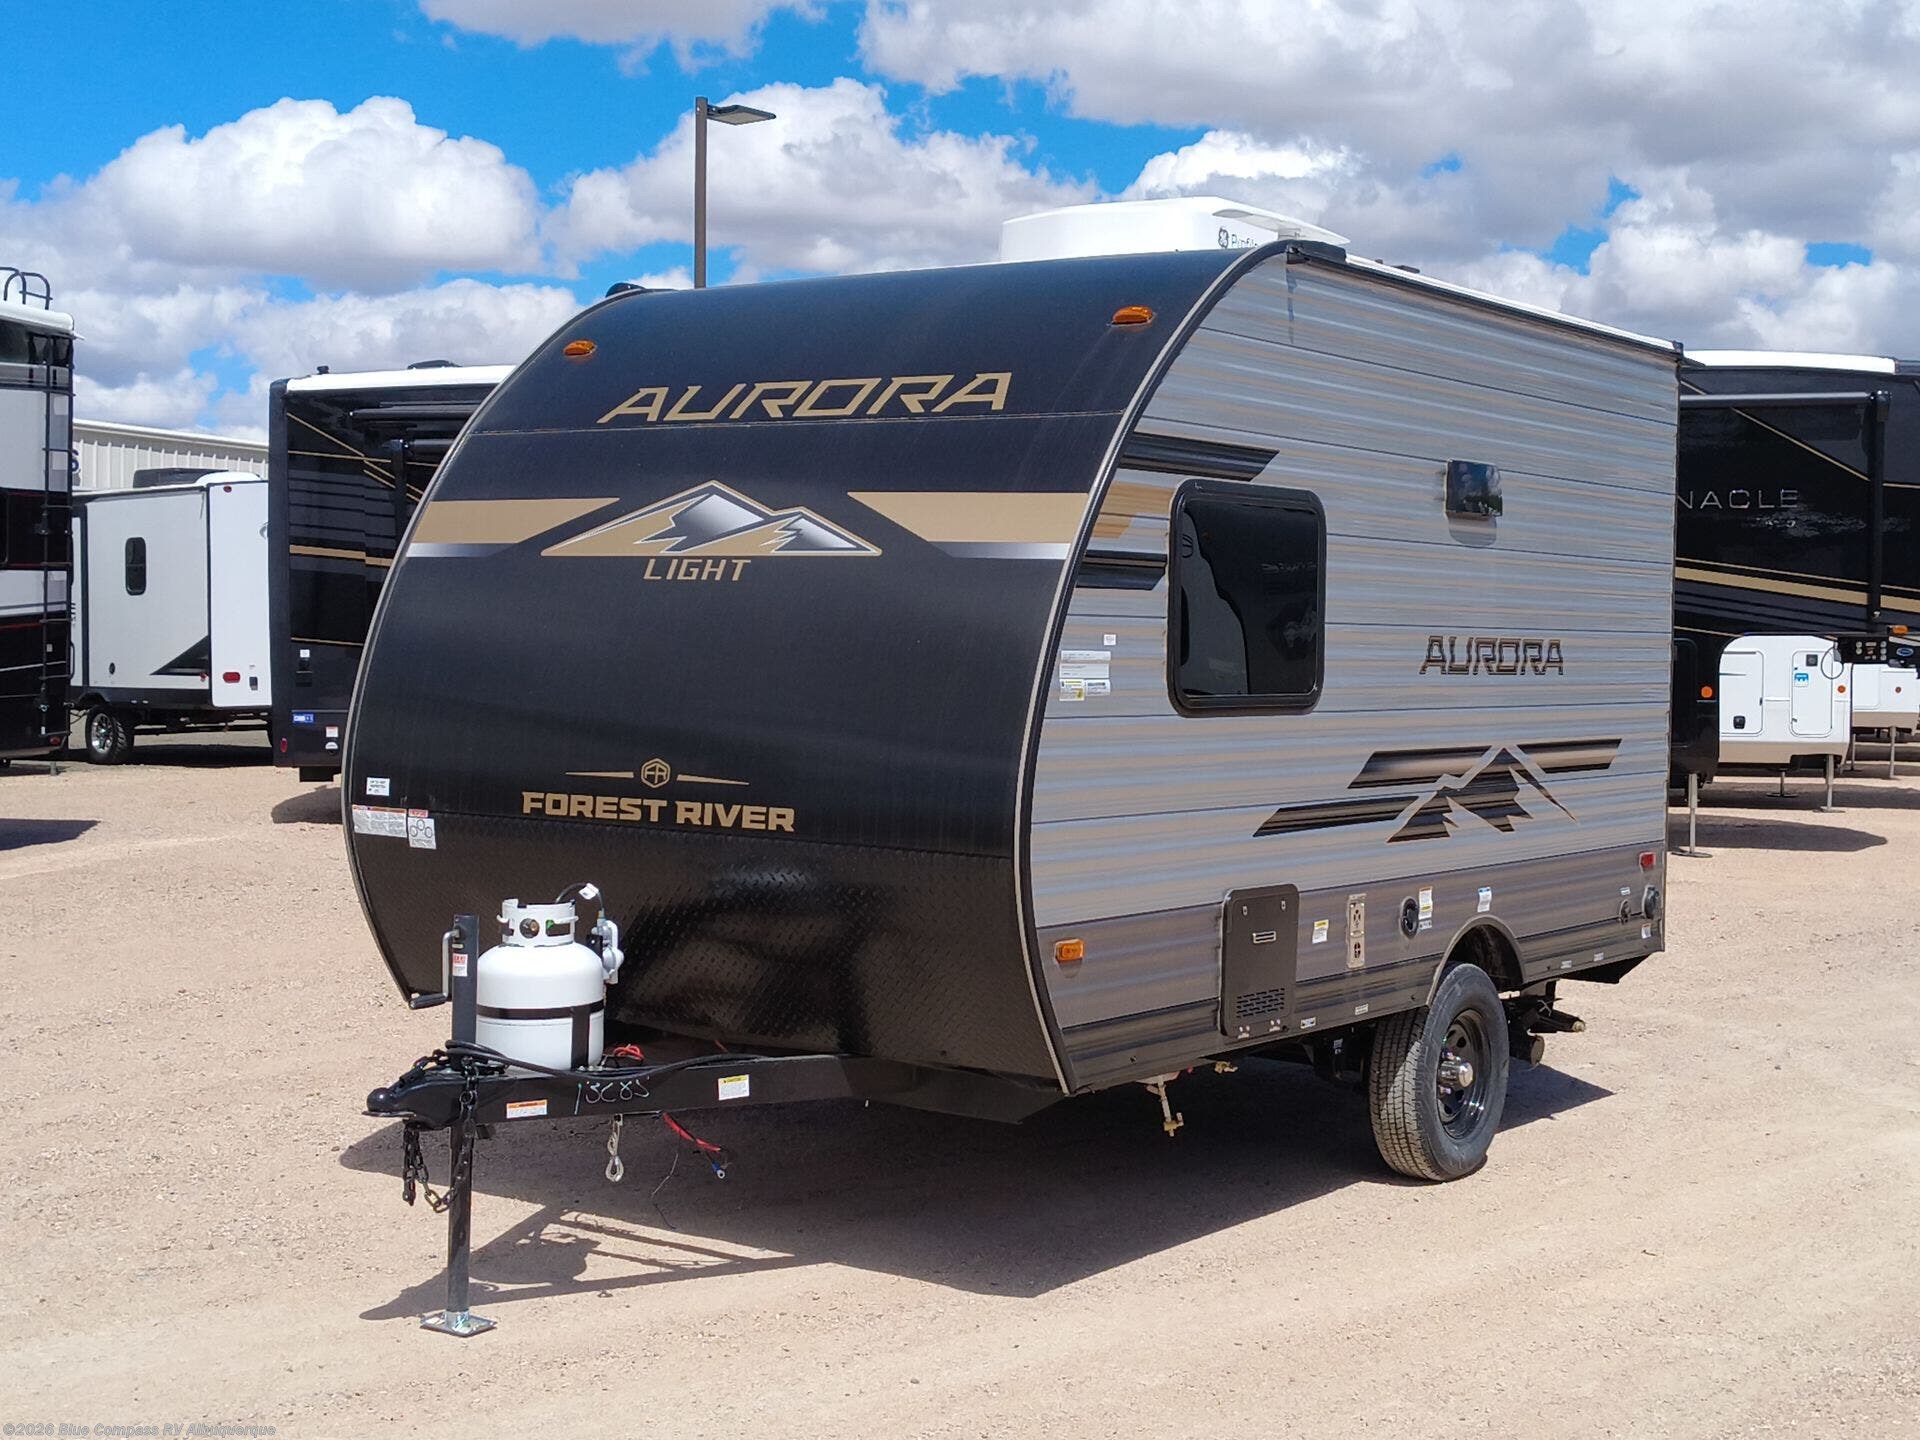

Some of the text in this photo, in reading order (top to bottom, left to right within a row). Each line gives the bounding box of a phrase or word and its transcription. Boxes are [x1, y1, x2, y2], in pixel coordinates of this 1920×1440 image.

[596, 371, 1013, 424] AURORA
[643, 557, 752, 582] LIGHT
[1419, 634, 1565, 677] AURORA
[522, 791, 795, 832] FOREST RIVER
